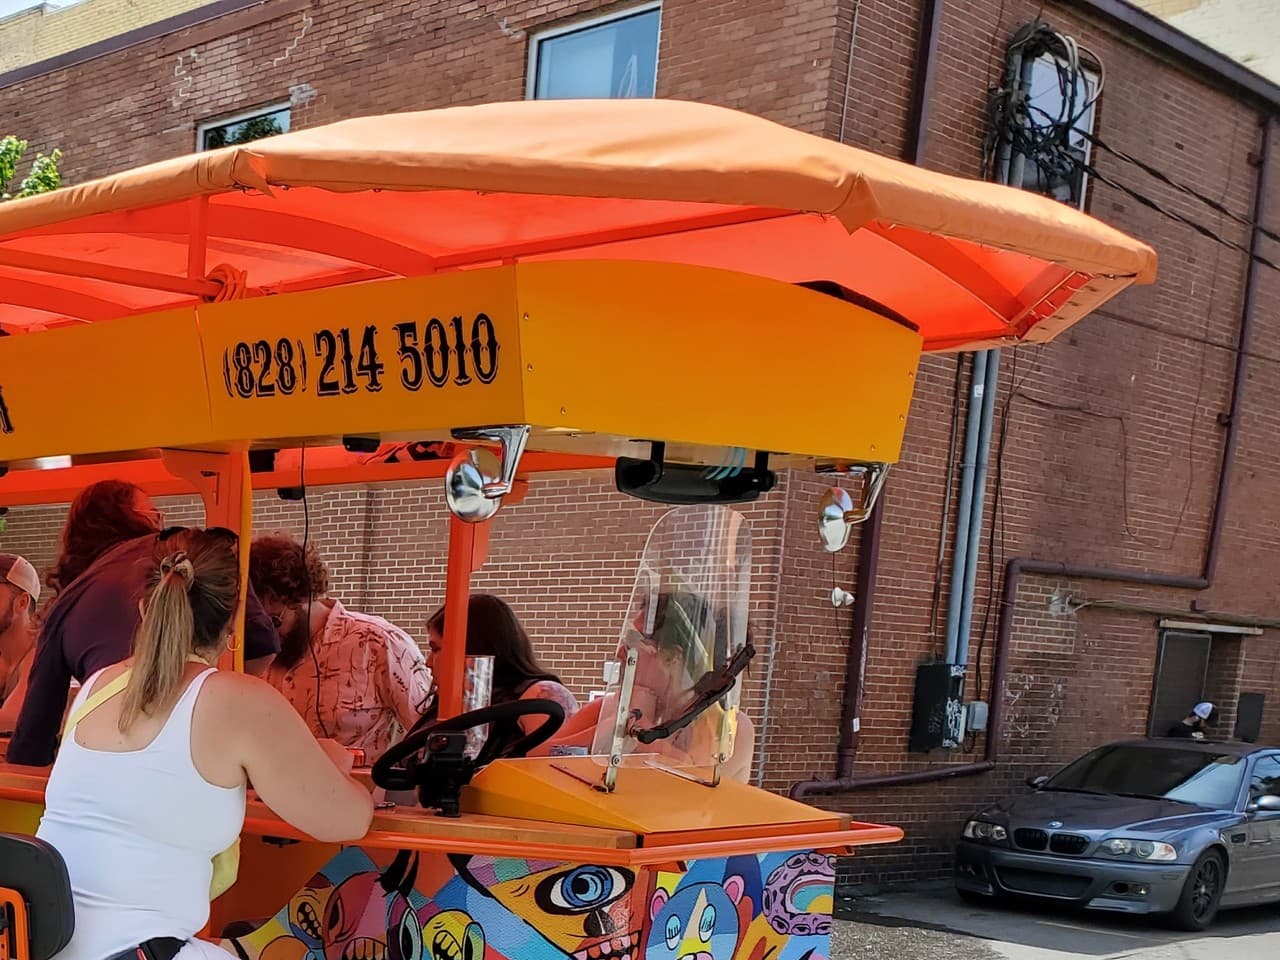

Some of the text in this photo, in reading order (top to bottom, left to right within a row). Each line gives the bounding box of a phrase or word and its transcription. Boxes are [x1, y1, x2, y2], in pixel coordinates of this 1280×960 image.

[223, 313, 500, 398] (828) 214 5010
